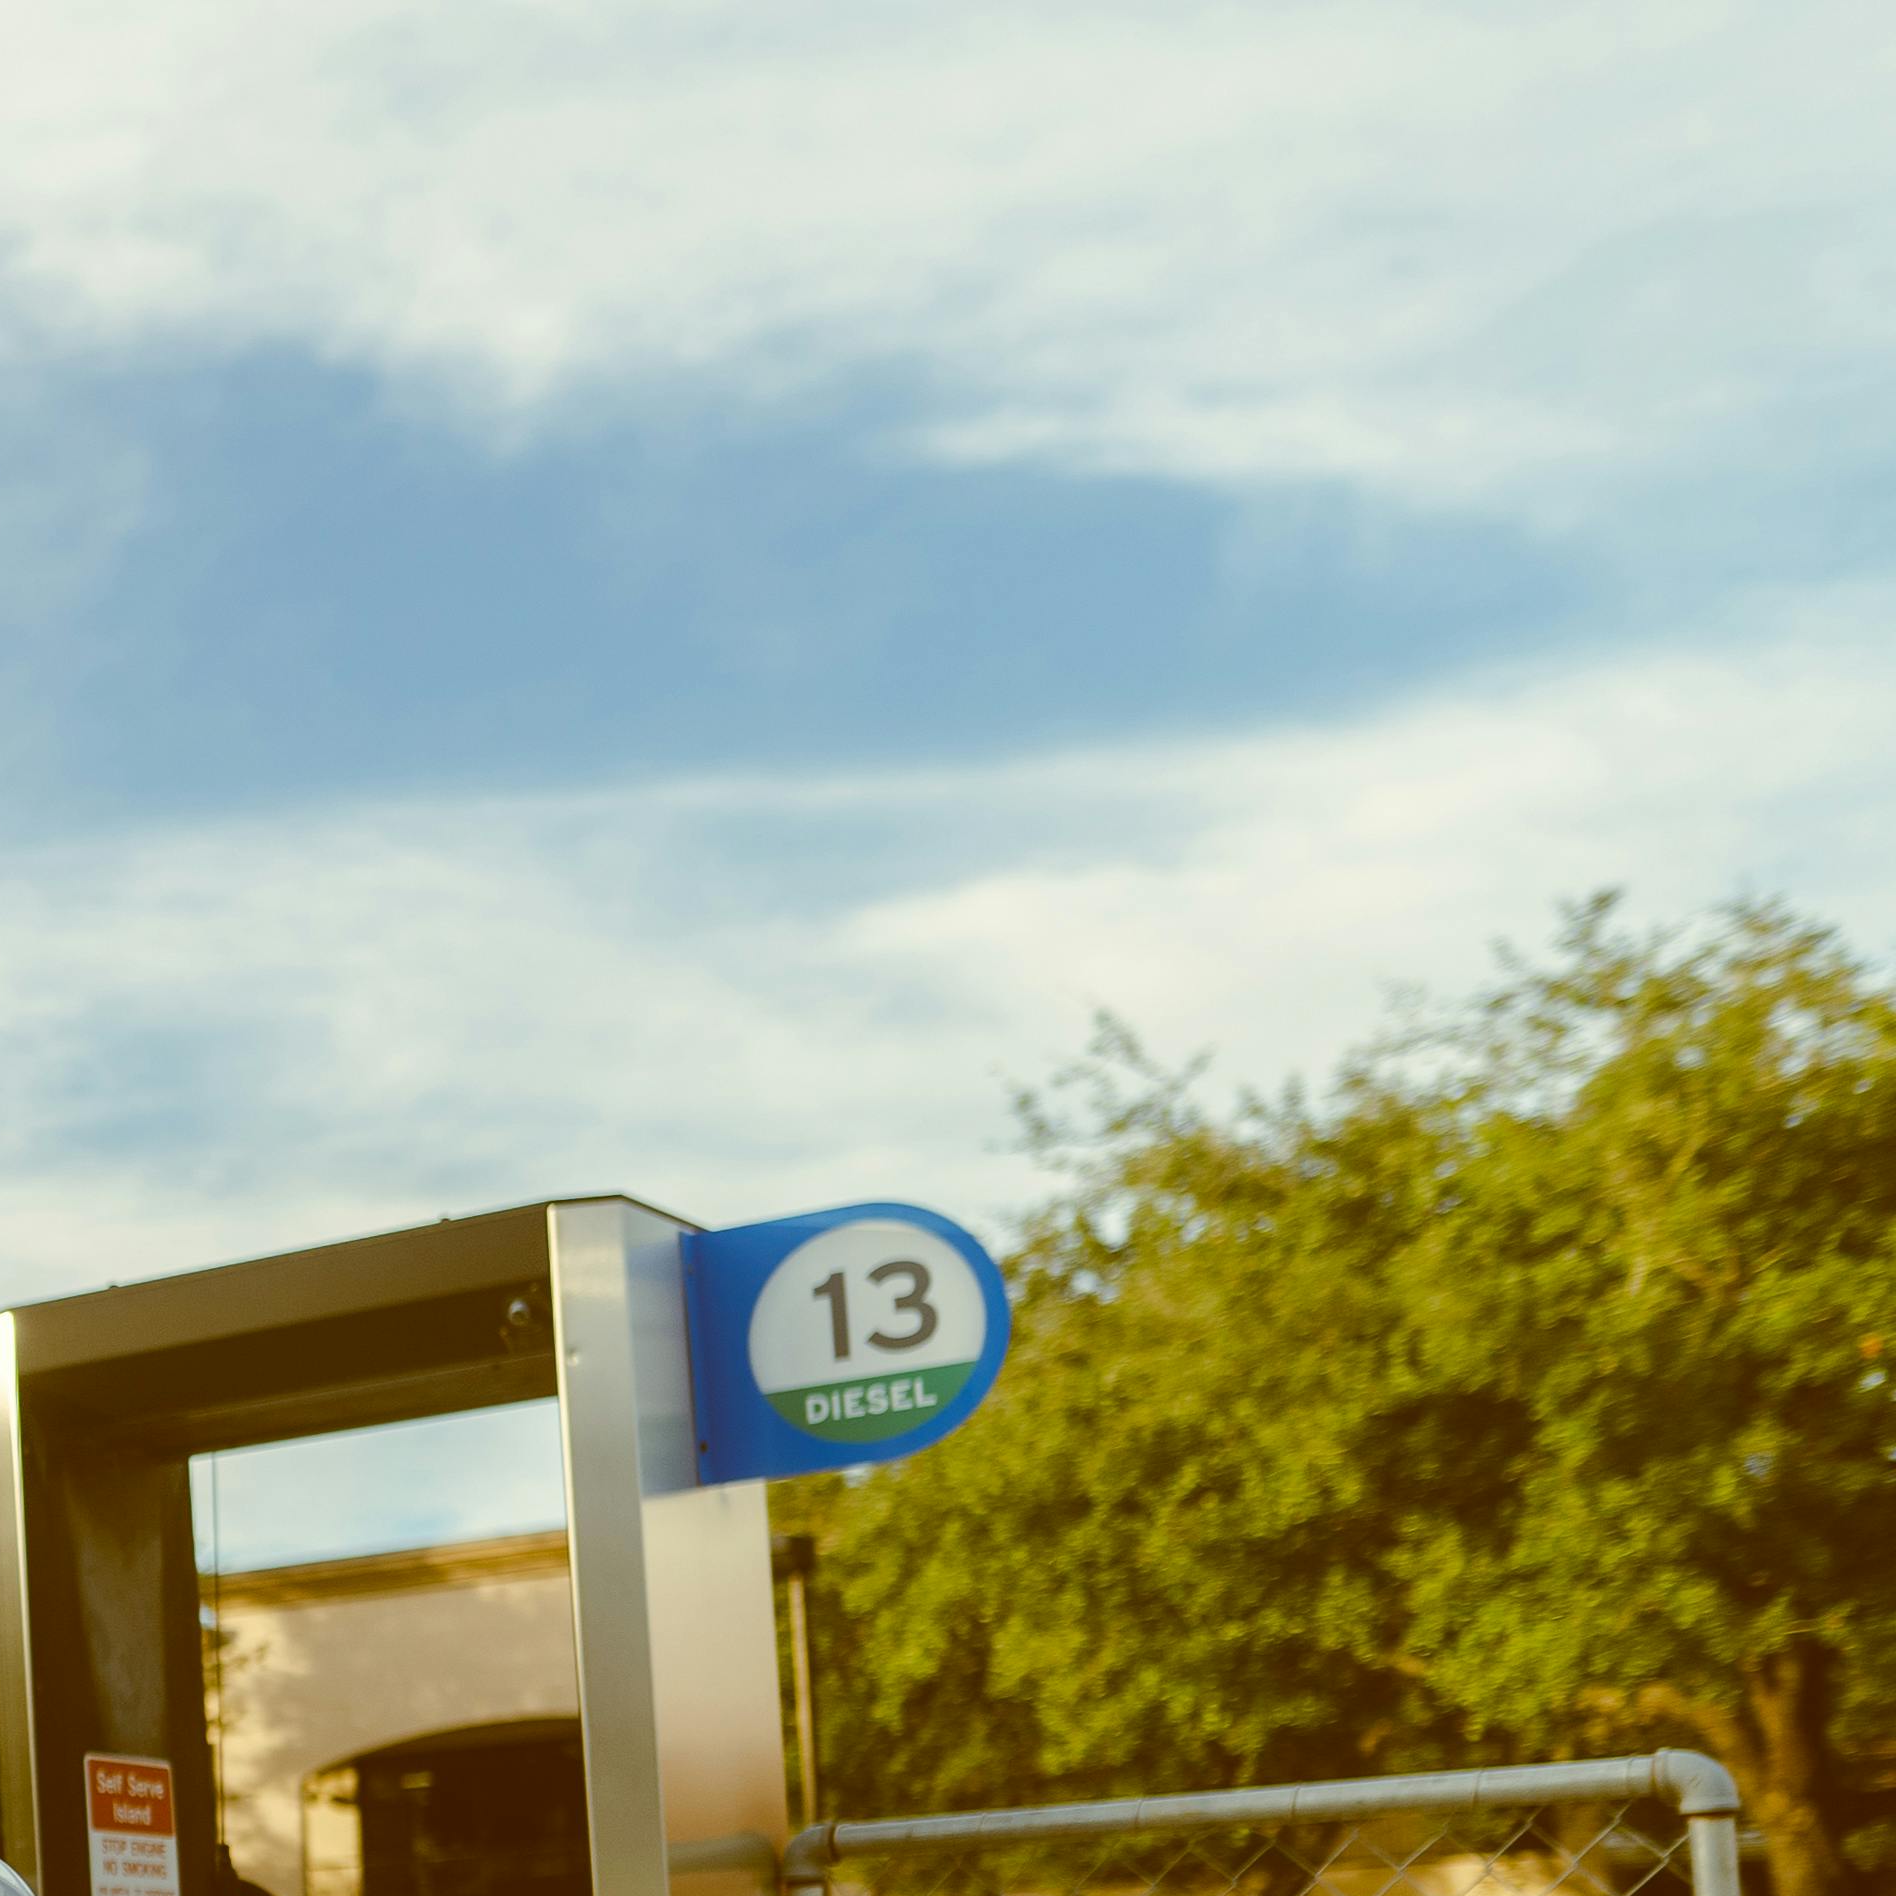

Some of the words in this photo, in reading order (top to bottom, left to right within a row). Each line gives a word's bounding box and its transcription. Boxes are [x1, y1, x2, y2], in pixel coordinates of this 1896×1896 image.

[813, 1260, 939, 1360] 13
[805, 1376, 939, 1424] DIESEL
[96, 1770, 123, 1795] Self
[127, 1774, 165, 1800] Serve
[113, 1803, 152, 1827] Island
[123, 1861, 168, 1880] SMOKING
